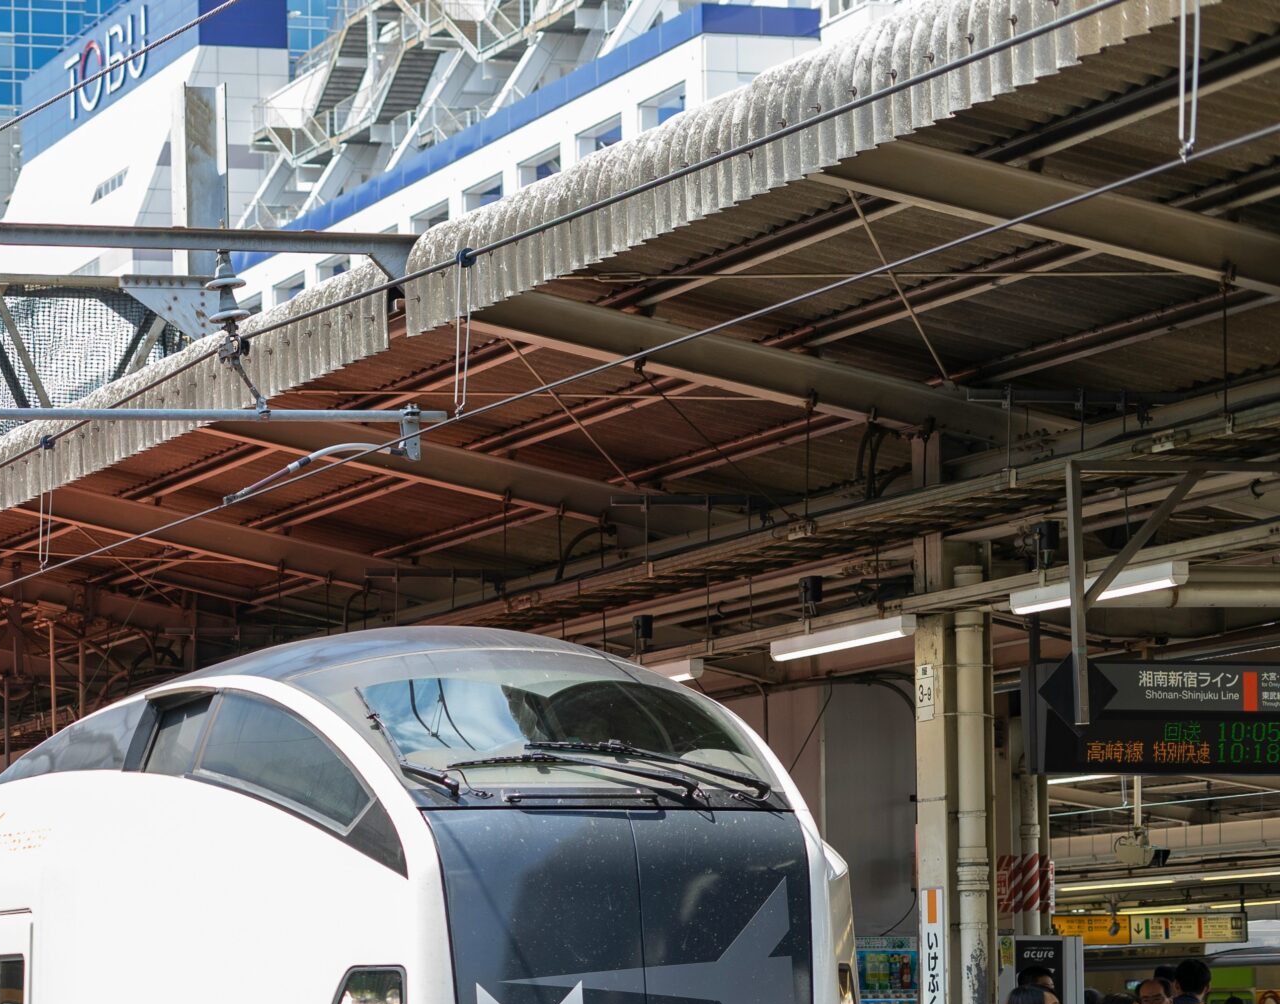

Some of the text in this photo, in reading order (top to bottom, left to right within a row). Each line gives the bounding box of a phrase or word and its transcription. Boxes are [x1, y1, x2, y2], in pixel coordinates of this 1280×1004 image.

[63, 4, 148, 121] TOBU
[1138, 670, 1240, 688] 湘南新宿ライン
[918, 684, 932, 703] 3-9
[1145, 689, 1240, 702] Shōnan-Shinjuku Line
[1164, 720, 1201, 743] 回送
[1218, 721, 1280, 742] 10:05
[1087, 740, 1211, 764] 高崎線 特別快速
[1217, 743, 1280, 763] 10:18
[1023, 950, 1055, 958] acure
